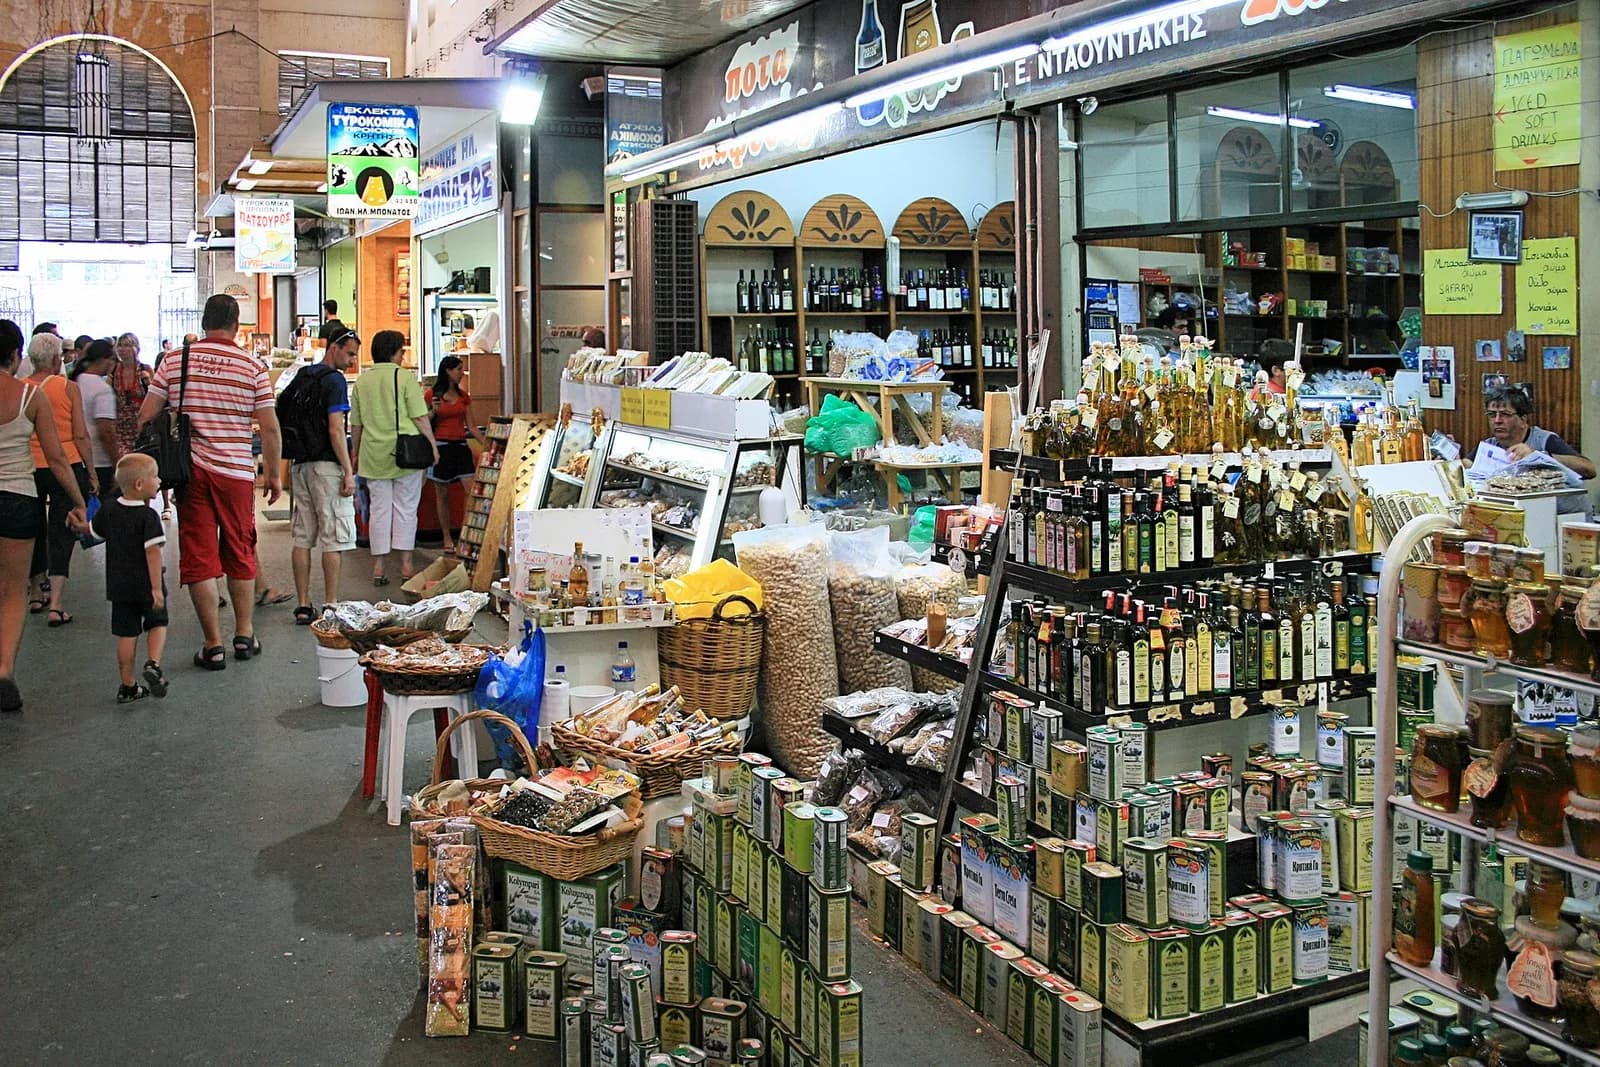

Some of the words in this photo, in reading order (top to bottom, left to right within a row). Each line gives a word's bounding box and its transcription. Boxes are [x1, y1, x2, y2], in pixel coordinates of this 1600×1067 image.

[344, 106, 406, 116] ΕΚΛΕΚΤΑ
[332, 115, 415, 129] ΤΥΡΟΚΟΜΙΚΑ
[1525, 111, 1558, 129] SOFT
